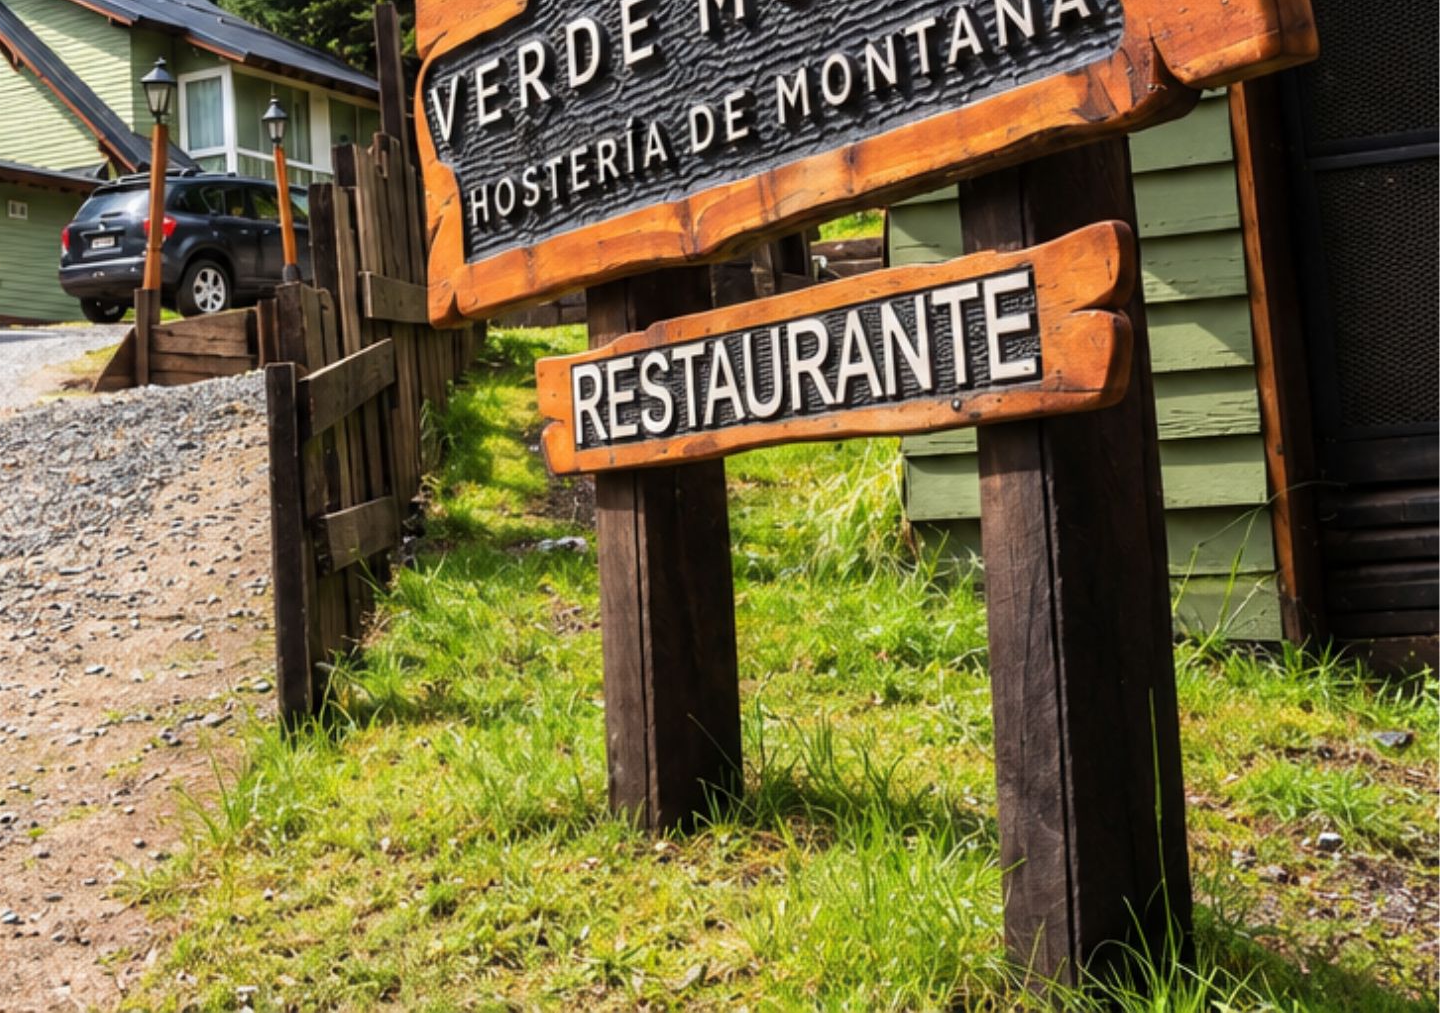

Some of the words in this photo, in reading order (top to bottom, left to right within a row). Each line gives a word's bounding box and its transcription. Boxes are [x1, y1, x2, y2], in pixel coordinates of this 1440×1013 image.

[470, 116, 668, 226] HOSTERÍA
[689, 88, 749, 155] DE
[572, 270, 1038, 445] RESTAURANTE
